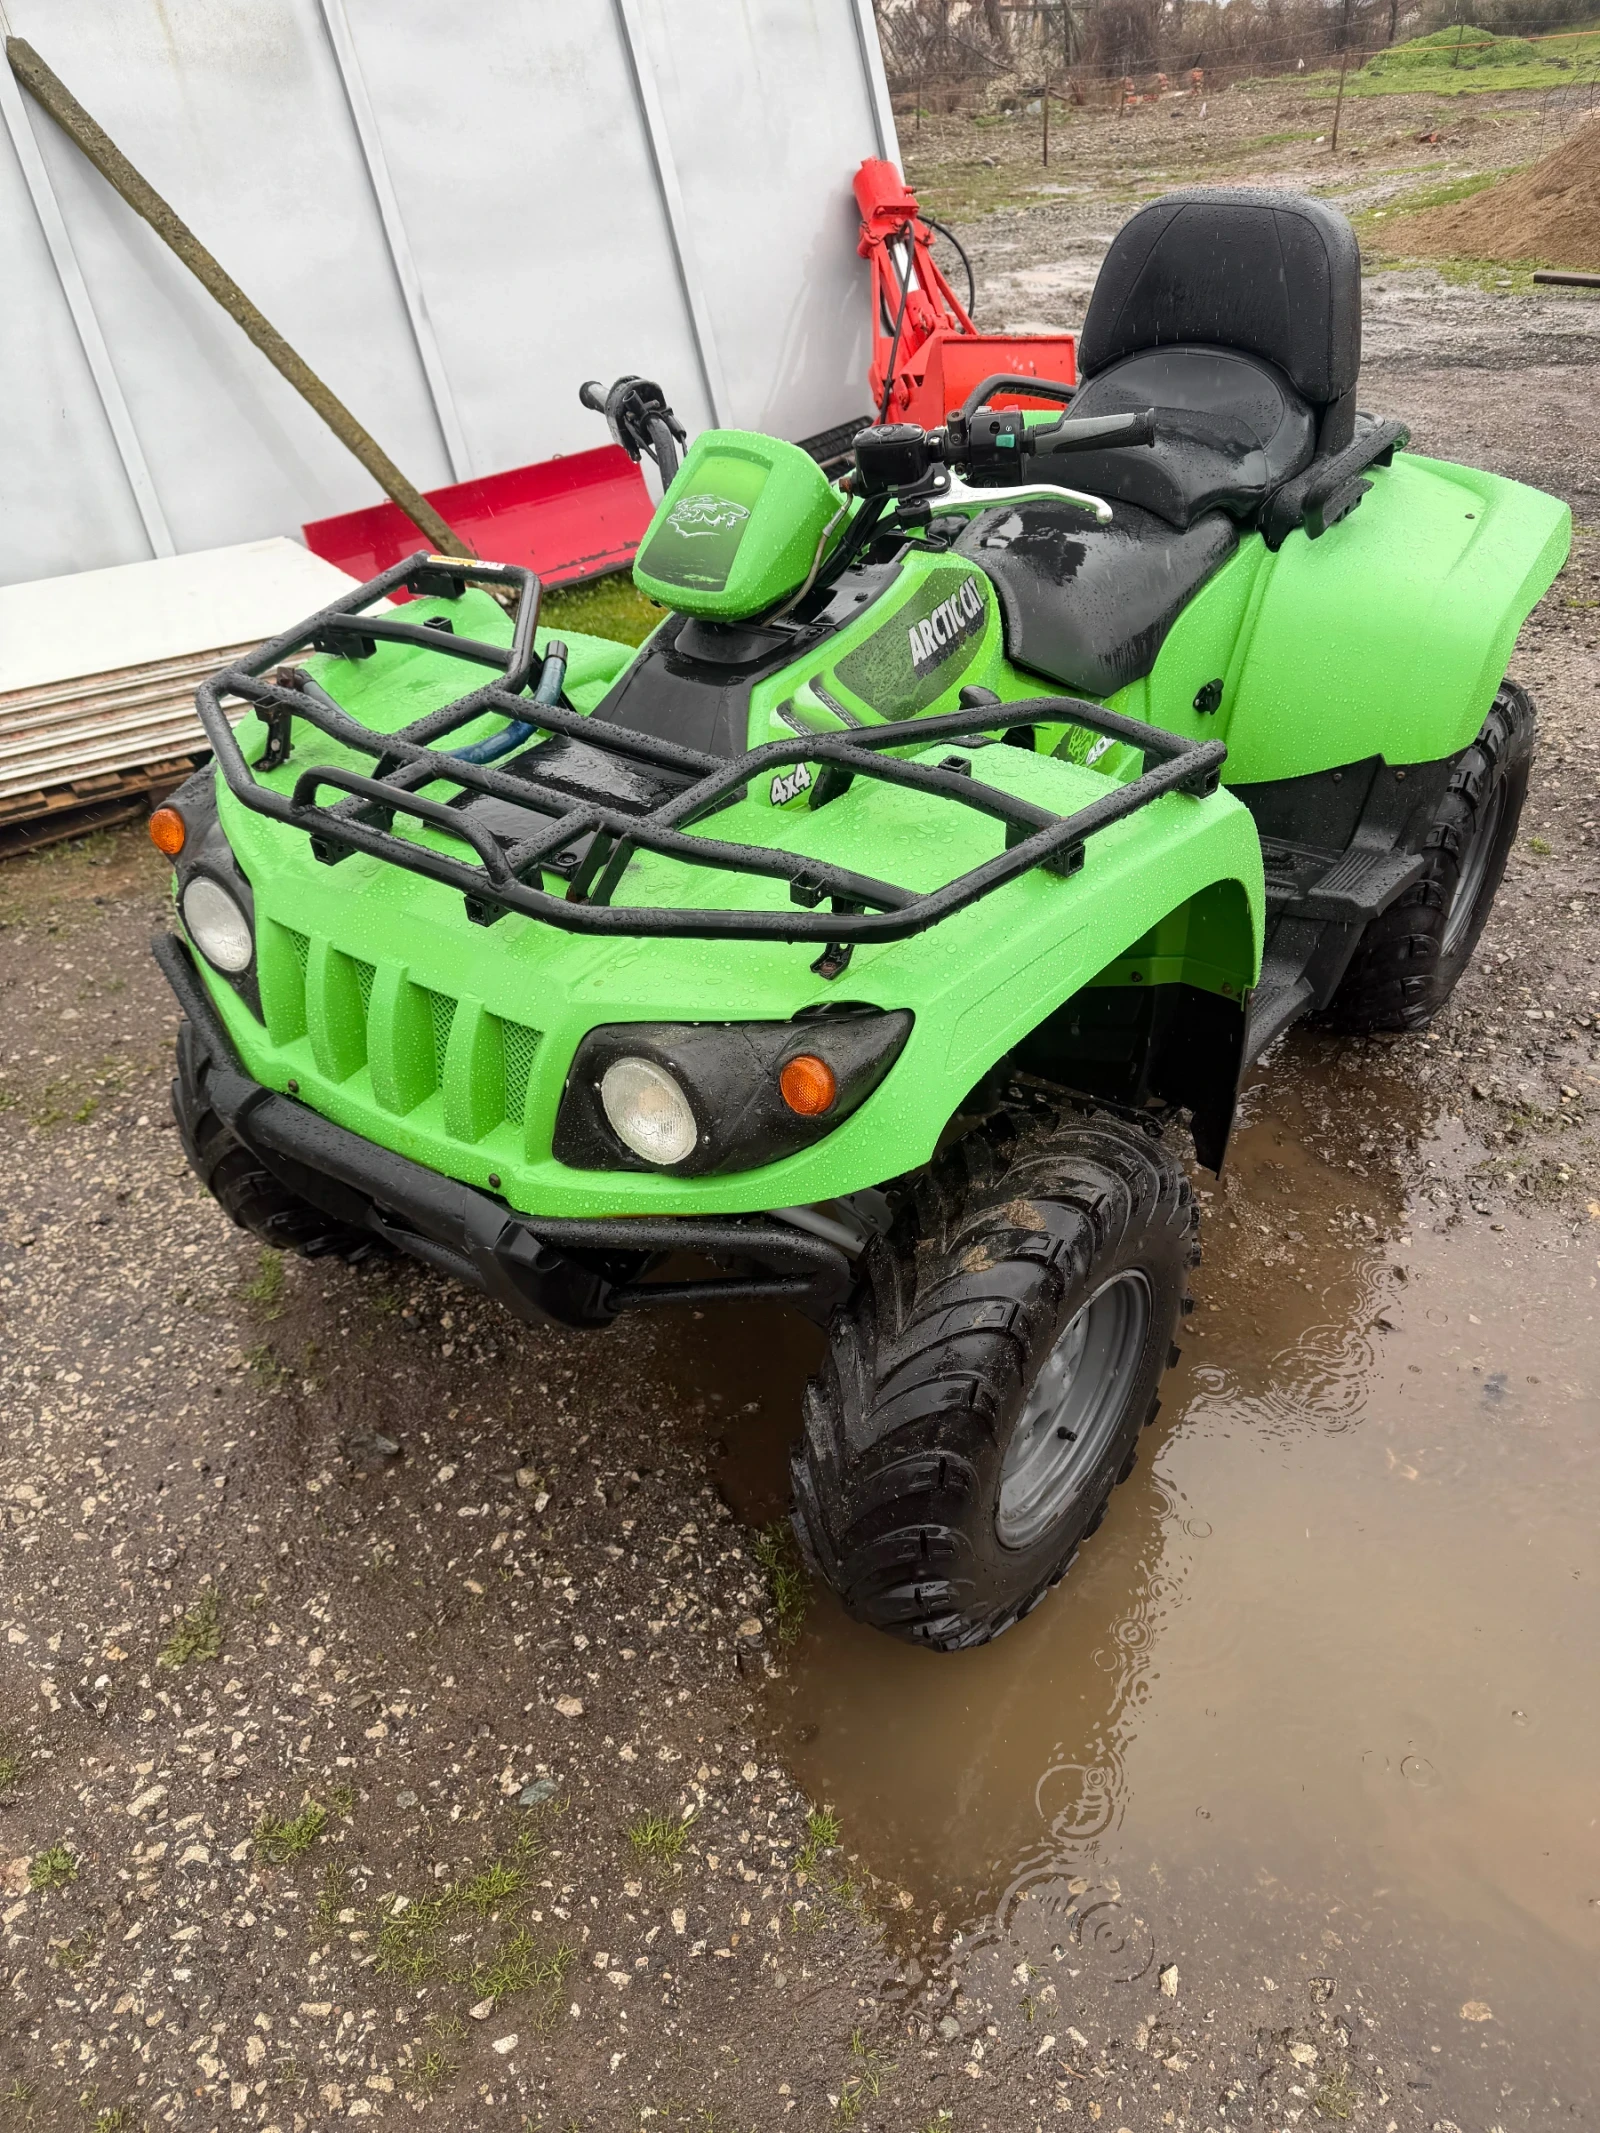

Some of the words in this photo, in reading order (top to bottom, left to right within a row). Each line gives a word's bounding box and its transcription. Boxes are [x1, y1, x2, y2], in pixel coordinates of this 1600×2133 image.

[908, 592, 966, 668] ARCTIC
[959, 574, 984, 619] CAT
[770, 761, 812, 806] 4x4
